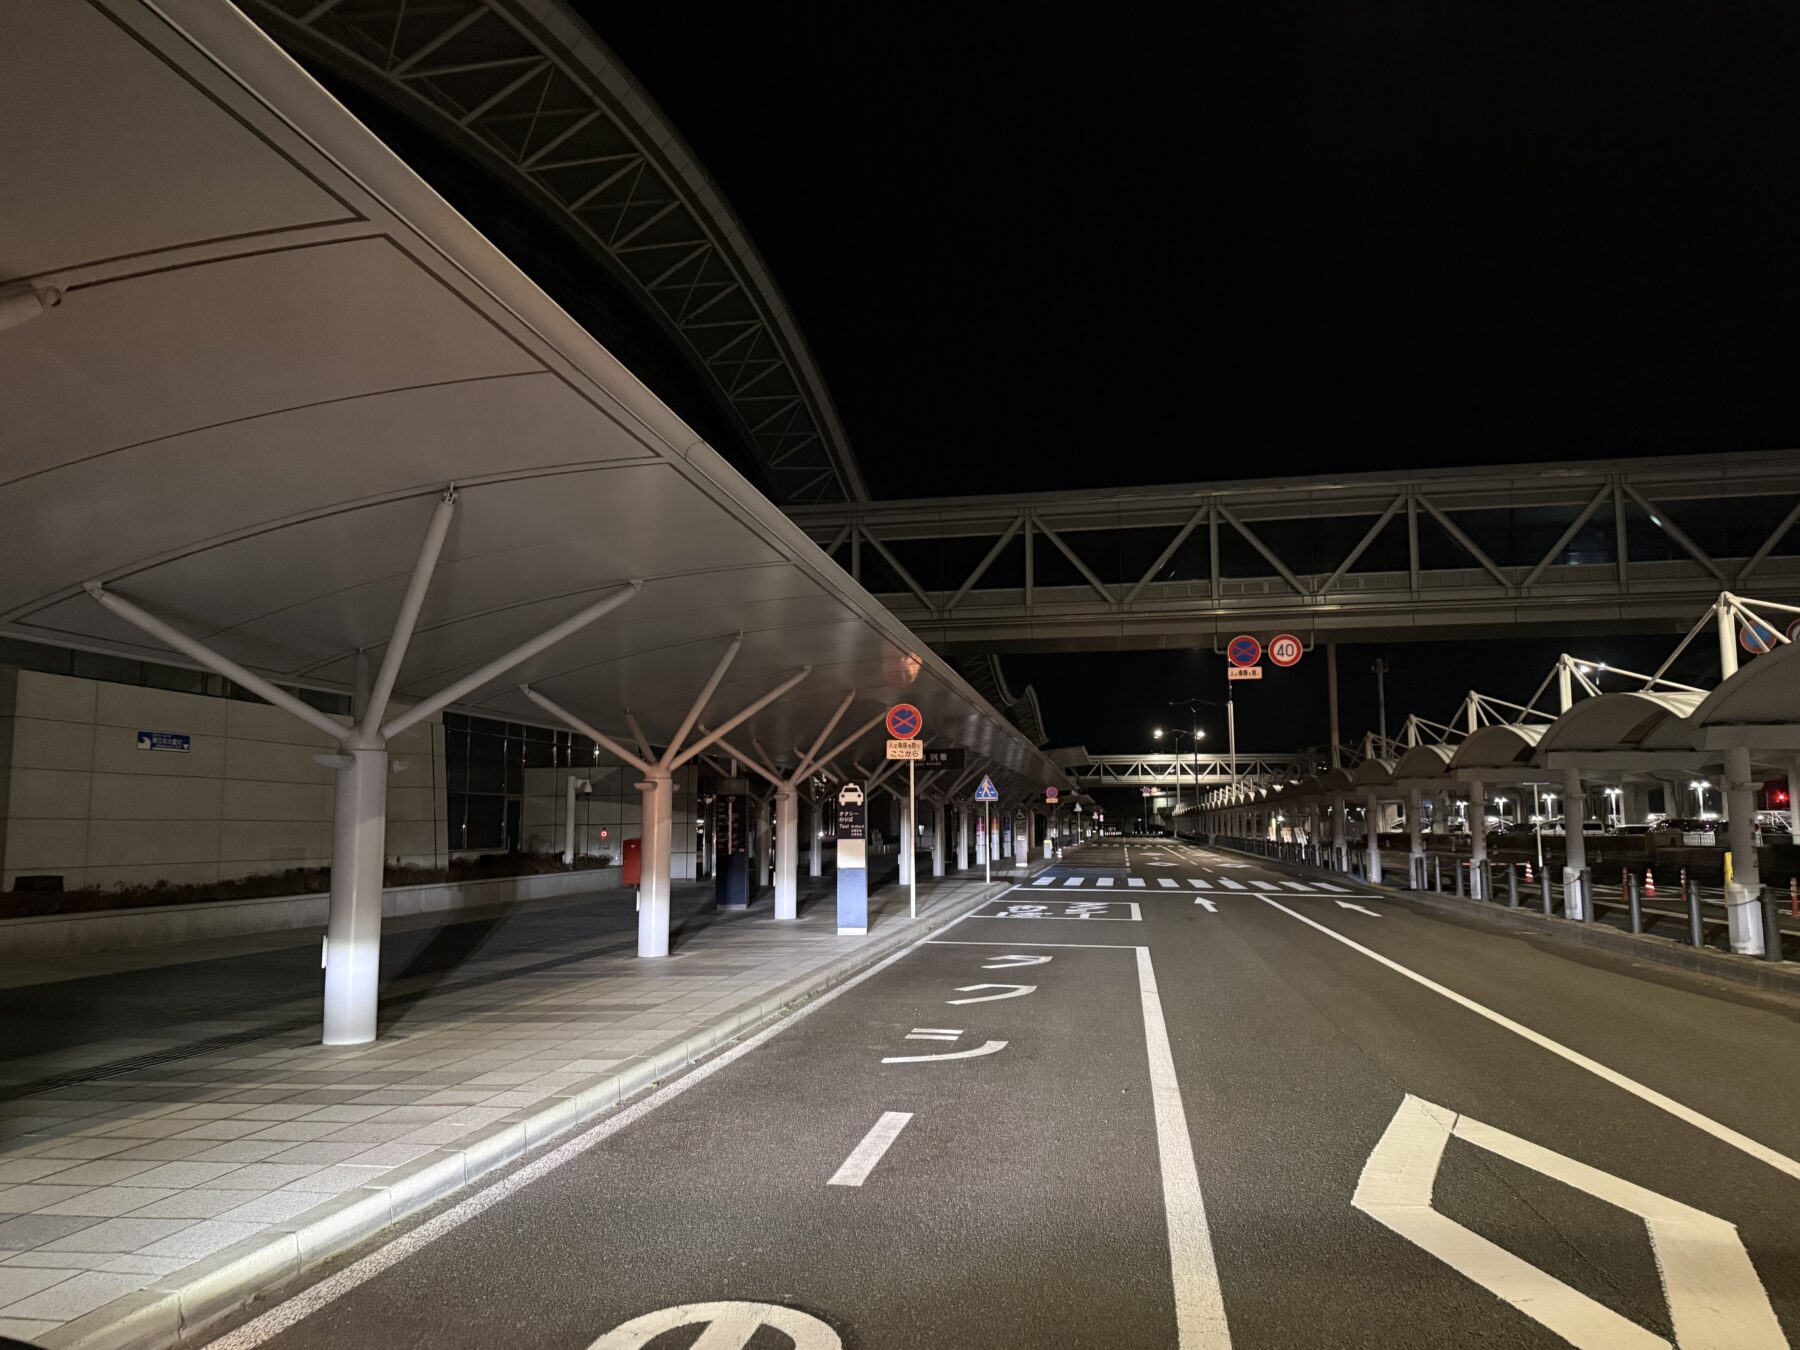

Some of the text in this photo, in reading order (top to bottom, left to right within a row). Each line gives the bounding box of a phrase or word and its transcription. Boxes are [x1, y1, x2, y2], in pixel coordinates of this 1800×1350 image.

[1276, 643, 1295, 657] 40
[890, 750, 919, 758] ここから
